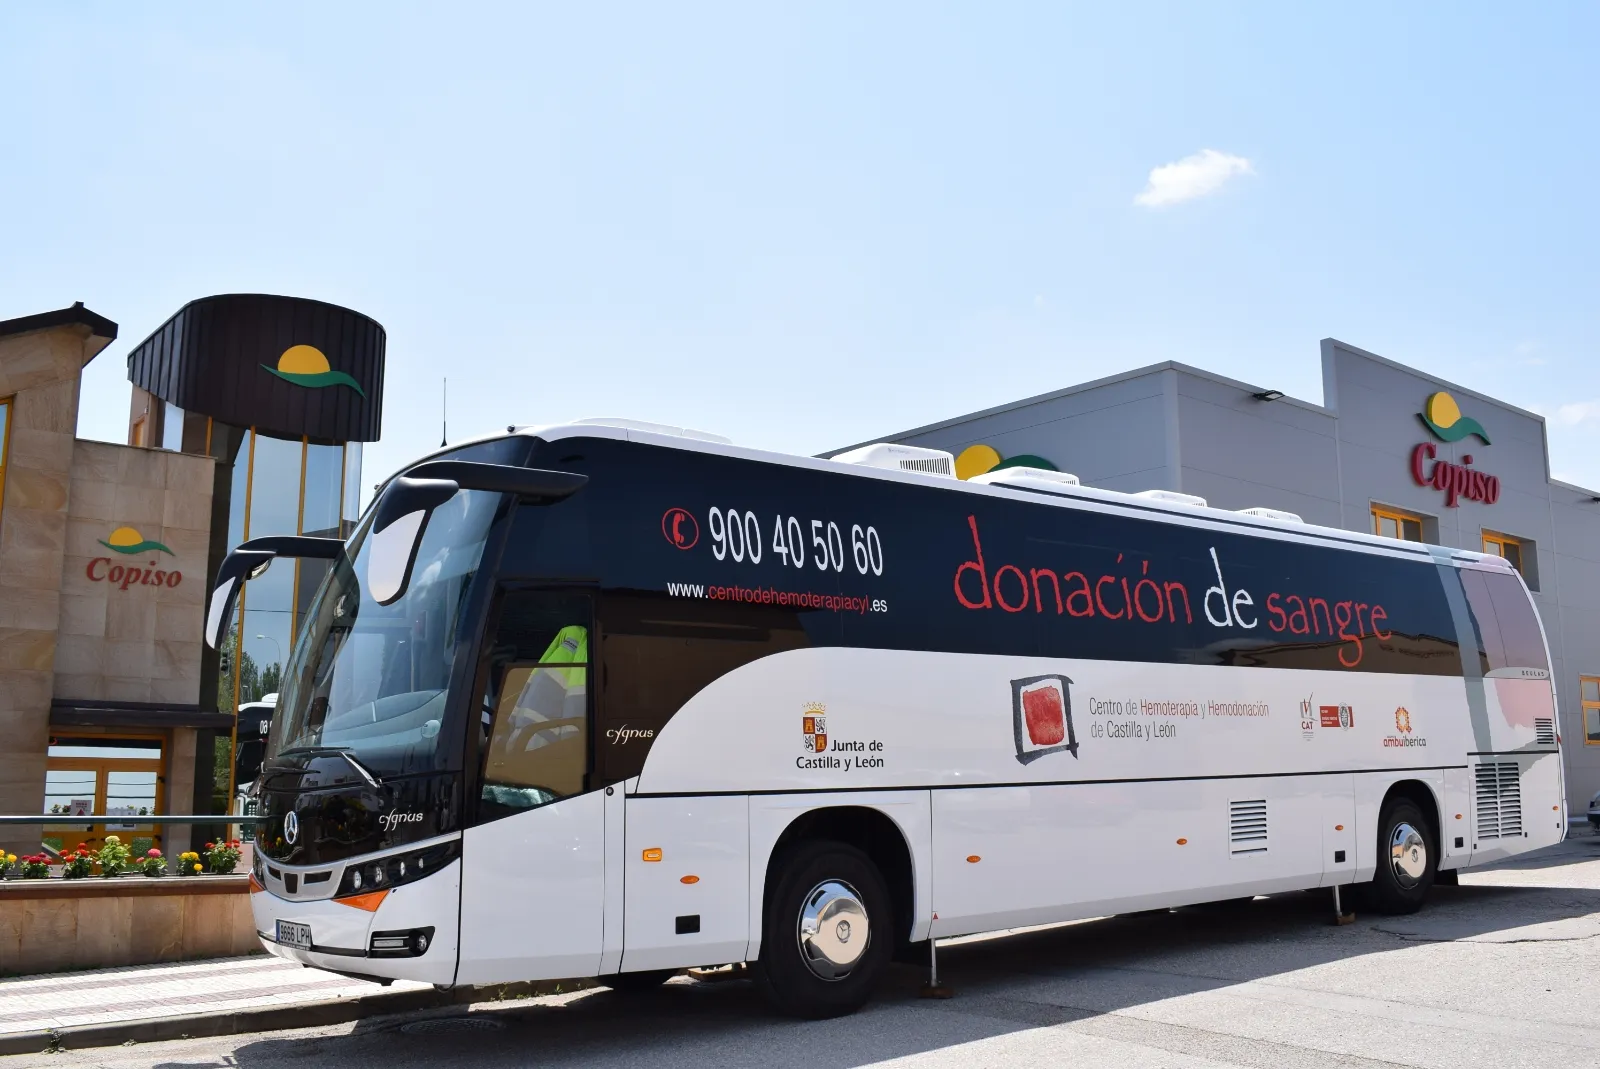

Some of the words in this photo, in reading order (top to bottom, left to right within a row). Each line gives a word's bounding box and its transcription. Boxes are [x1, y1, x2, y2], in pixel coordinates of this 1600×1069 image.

[1411, 442, 1500, 508] Copiso
[709, 506, 762, 565] 900
[773, 514, 805, 569] 40
[811, 519, 844, 573] 50
[851, 524, 883, 577] 60
[86, 557, 182, 590] Copiso
[667, 582, 888, 614] www.centrodehemoterapiacyl.es
[954, 515, 1192, 624] donación
[1204, 547, 1257, 629] de
[1267, 591, 1391, 668] sangre
[1089, 697, 1123, 715] Centro
[1125, 698, 1138, 715] de
[1140, 698, 1198, 719] Hemoterapia
[1200, 702, 1206, 720] y
[1208, 699, 1270, 717] Hemodonación
[606, 723, 654, 745] cygnus
[1091, 721, 1104, 738] de
[1107, 720, 1143, 738] Castilla
[1144, 723, 1151, 741] y
[1153, 720, 1176, 738] León
[1301, 721, 1314, 730] CAT
[830, 739, 865, 752] Junta
[868, 739, 884, 752] de
[796, 756, 841, 769] Castilla
[844, 758, 852, 772] y
[855, 755, 884, 768] León
[378, 808, 424, 831] cygnus
[296, 926, 311, 945] LPH
